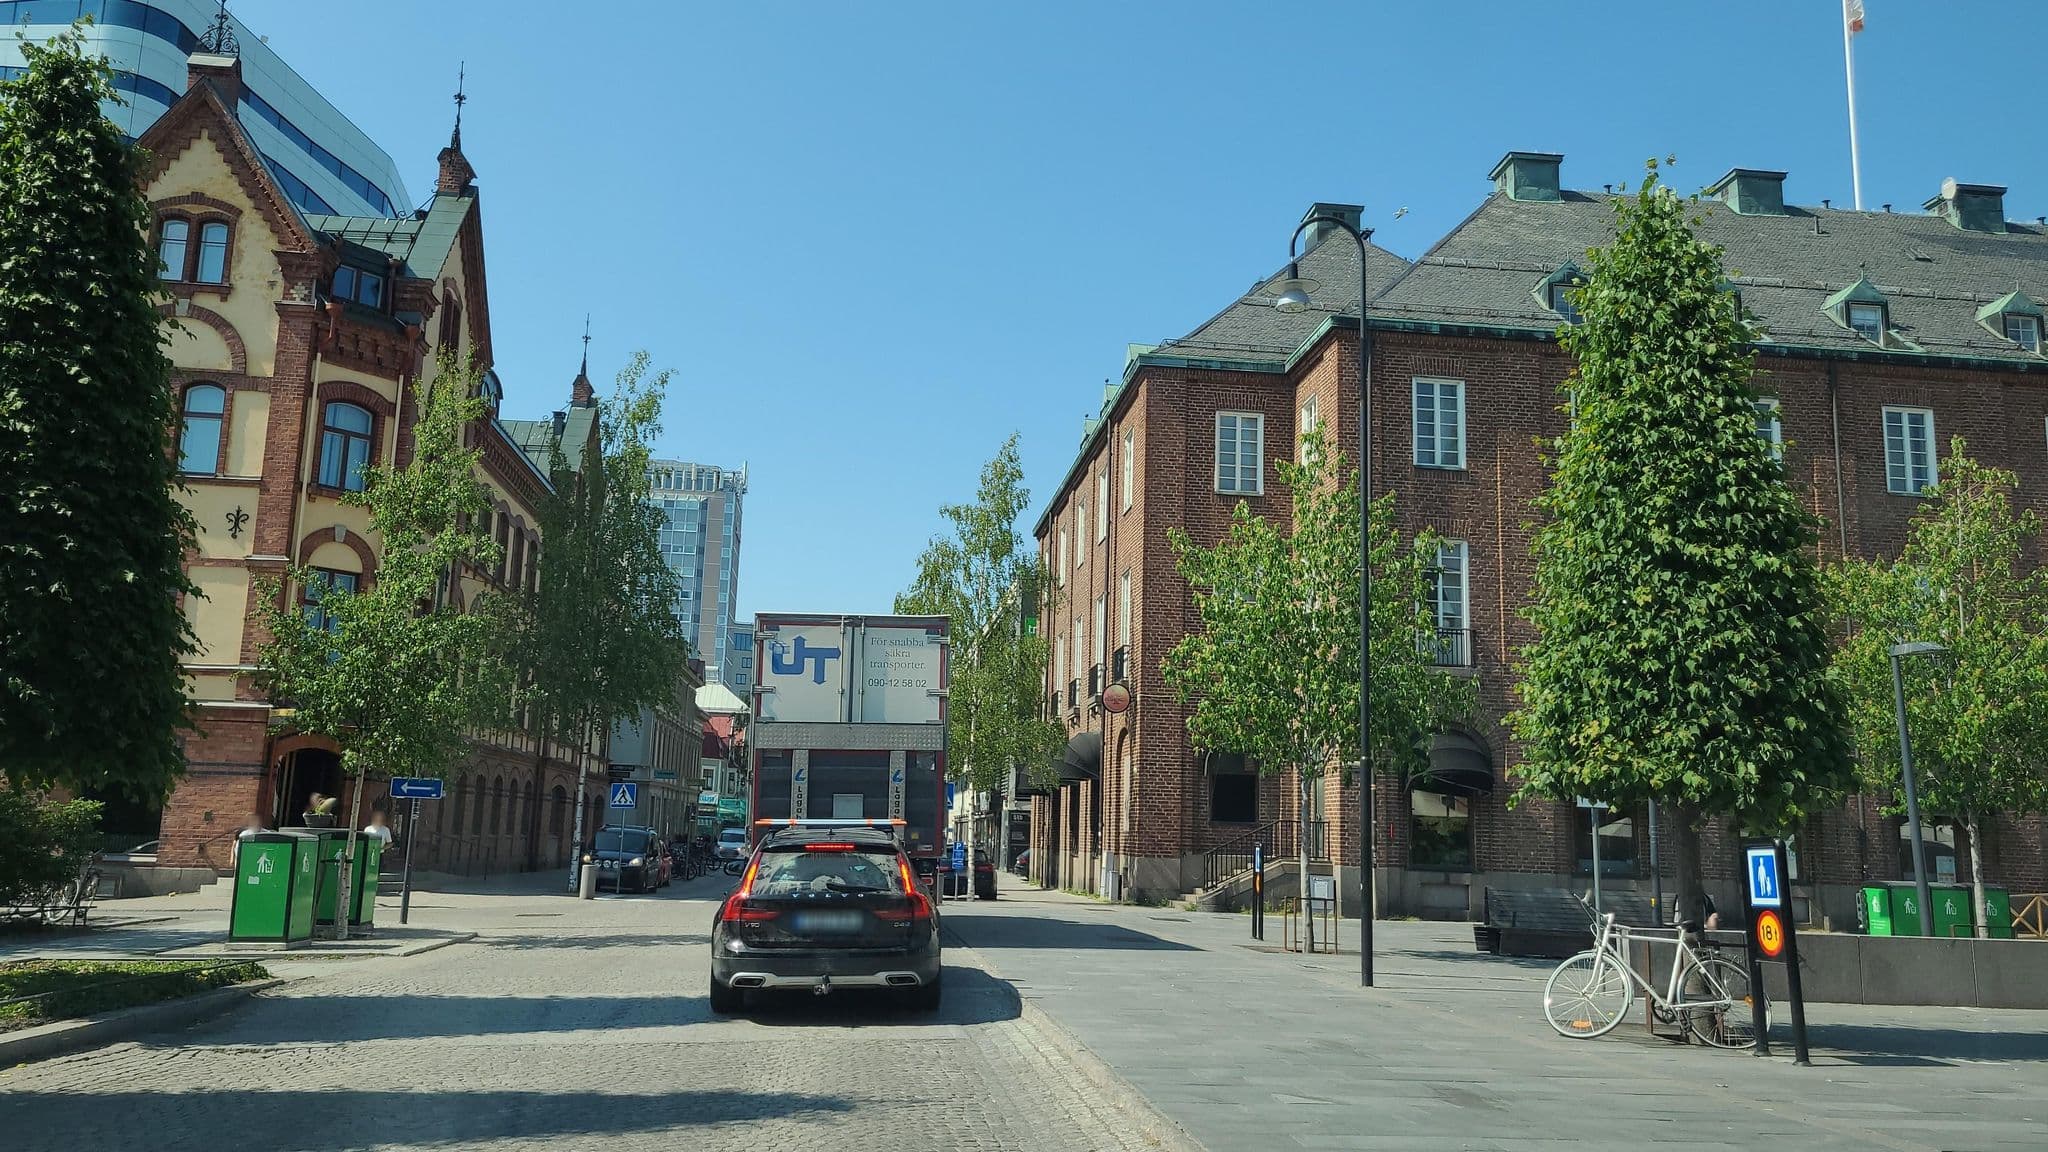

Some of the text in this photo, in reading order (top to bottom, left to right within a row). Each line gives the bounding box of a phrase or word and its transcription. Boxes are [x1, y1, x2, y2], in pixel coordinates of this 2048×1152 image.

[871, 637, 924, 646] För snabba
[885, 648, 911, 657] säkra
[868, 679, 927, 688] 090-12 58 02
[1761, 925, 1772, 940] 18
